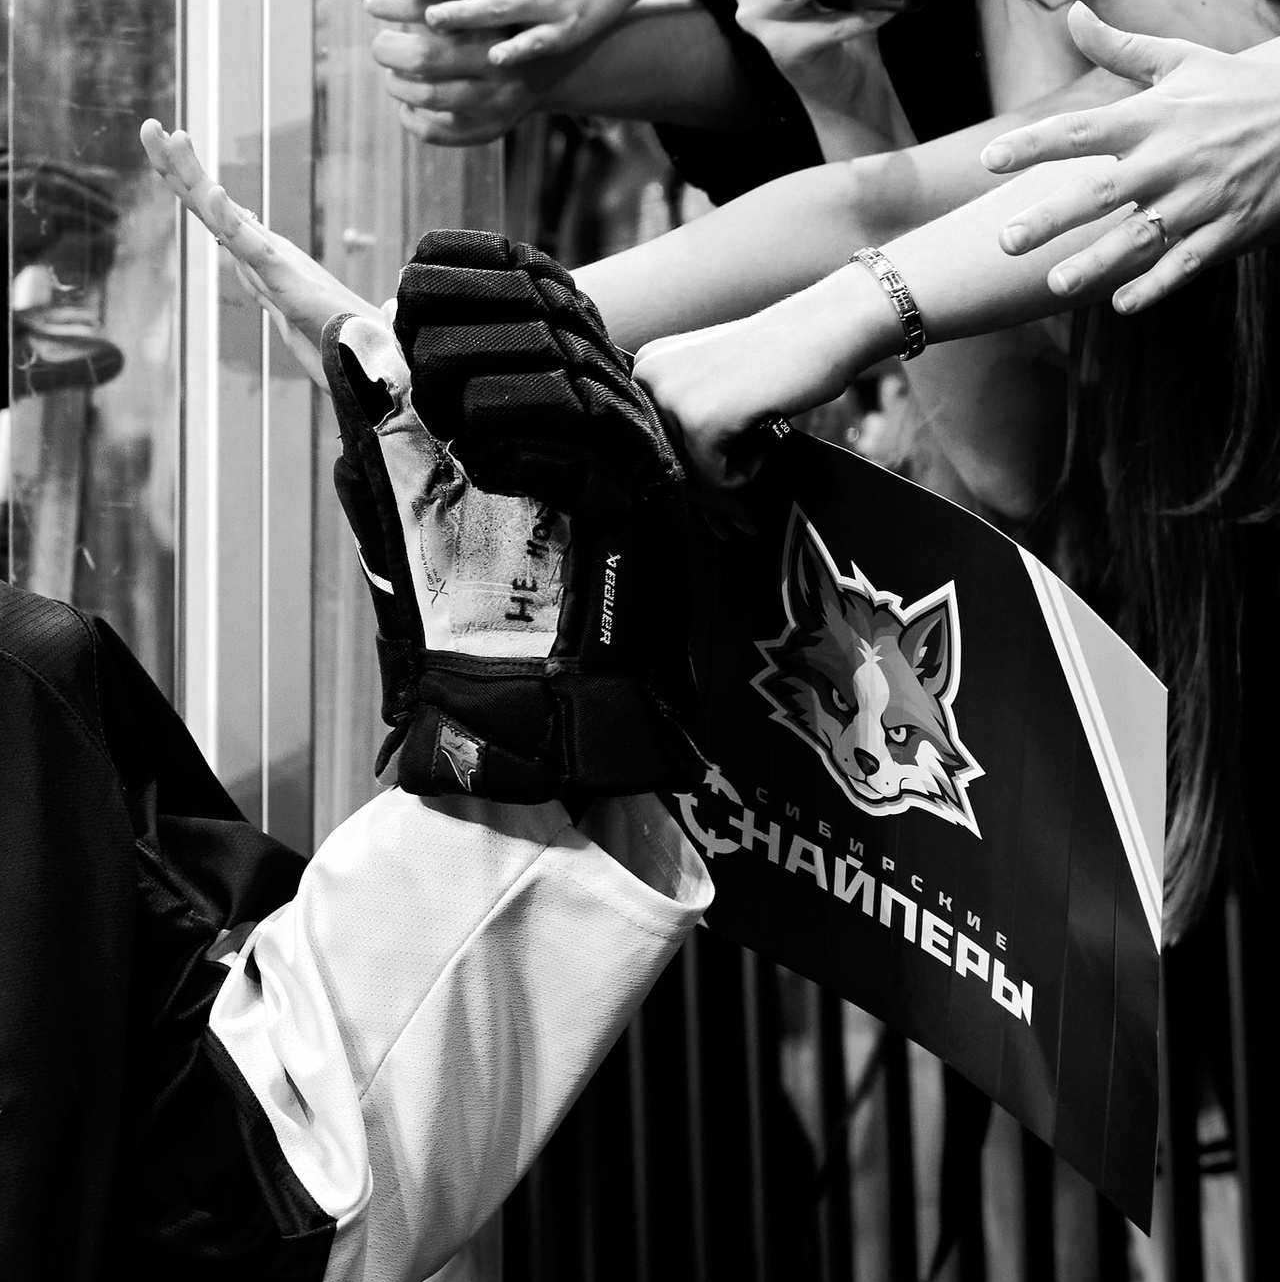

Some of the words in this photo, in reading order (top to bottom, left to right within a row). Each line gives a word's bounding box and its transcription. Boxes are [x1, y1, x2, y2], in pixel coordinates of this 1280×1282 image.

[778, 418, 791, 433] 120
[600, 568, 618, 645] BAUER
[672, 763, 1034, 1027] СНАЙПЕРЫ
[755, 786, 1008, 952] СИБИРСКИЕ
